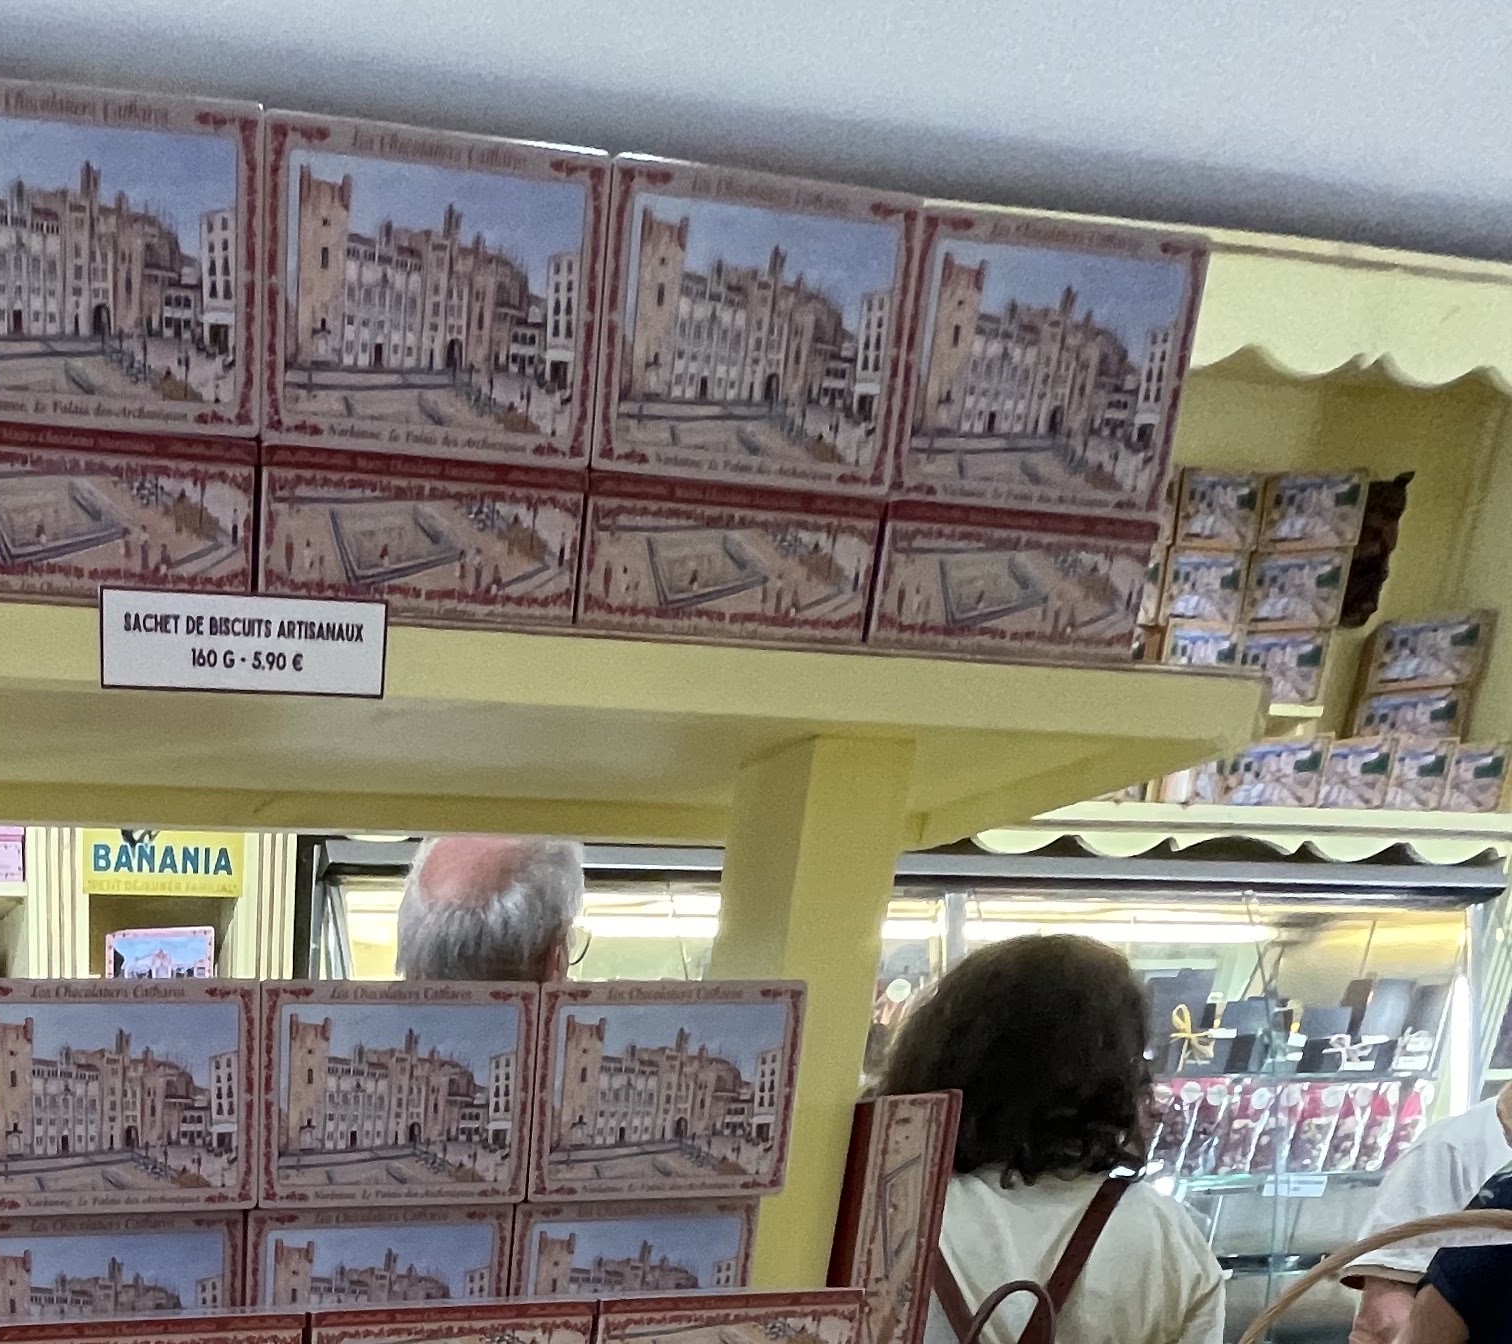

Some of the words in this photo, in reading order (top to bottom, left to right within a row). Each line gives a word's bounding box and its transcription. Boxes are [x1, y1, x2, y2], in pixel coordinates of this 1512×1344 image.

[124, 612, 181, 634] SACHET
[186, 615, 205, 636] DE
[210, 616, 272, 638] BISCUITS
[277, 621, 365, 643] ARTISANAUX
[192, 648, 218, 667] 160
[223, 650, 235, 669] G
[252, 651, 287, 672] 5.90
[292, 653, 304, 671] €
[93, 844, 233, 875] BANANIA
[29, 984, 50, 998] Les
[54, 983, 128, 998] Chocolatiers
[132, 983, 185, 998] Cathares
